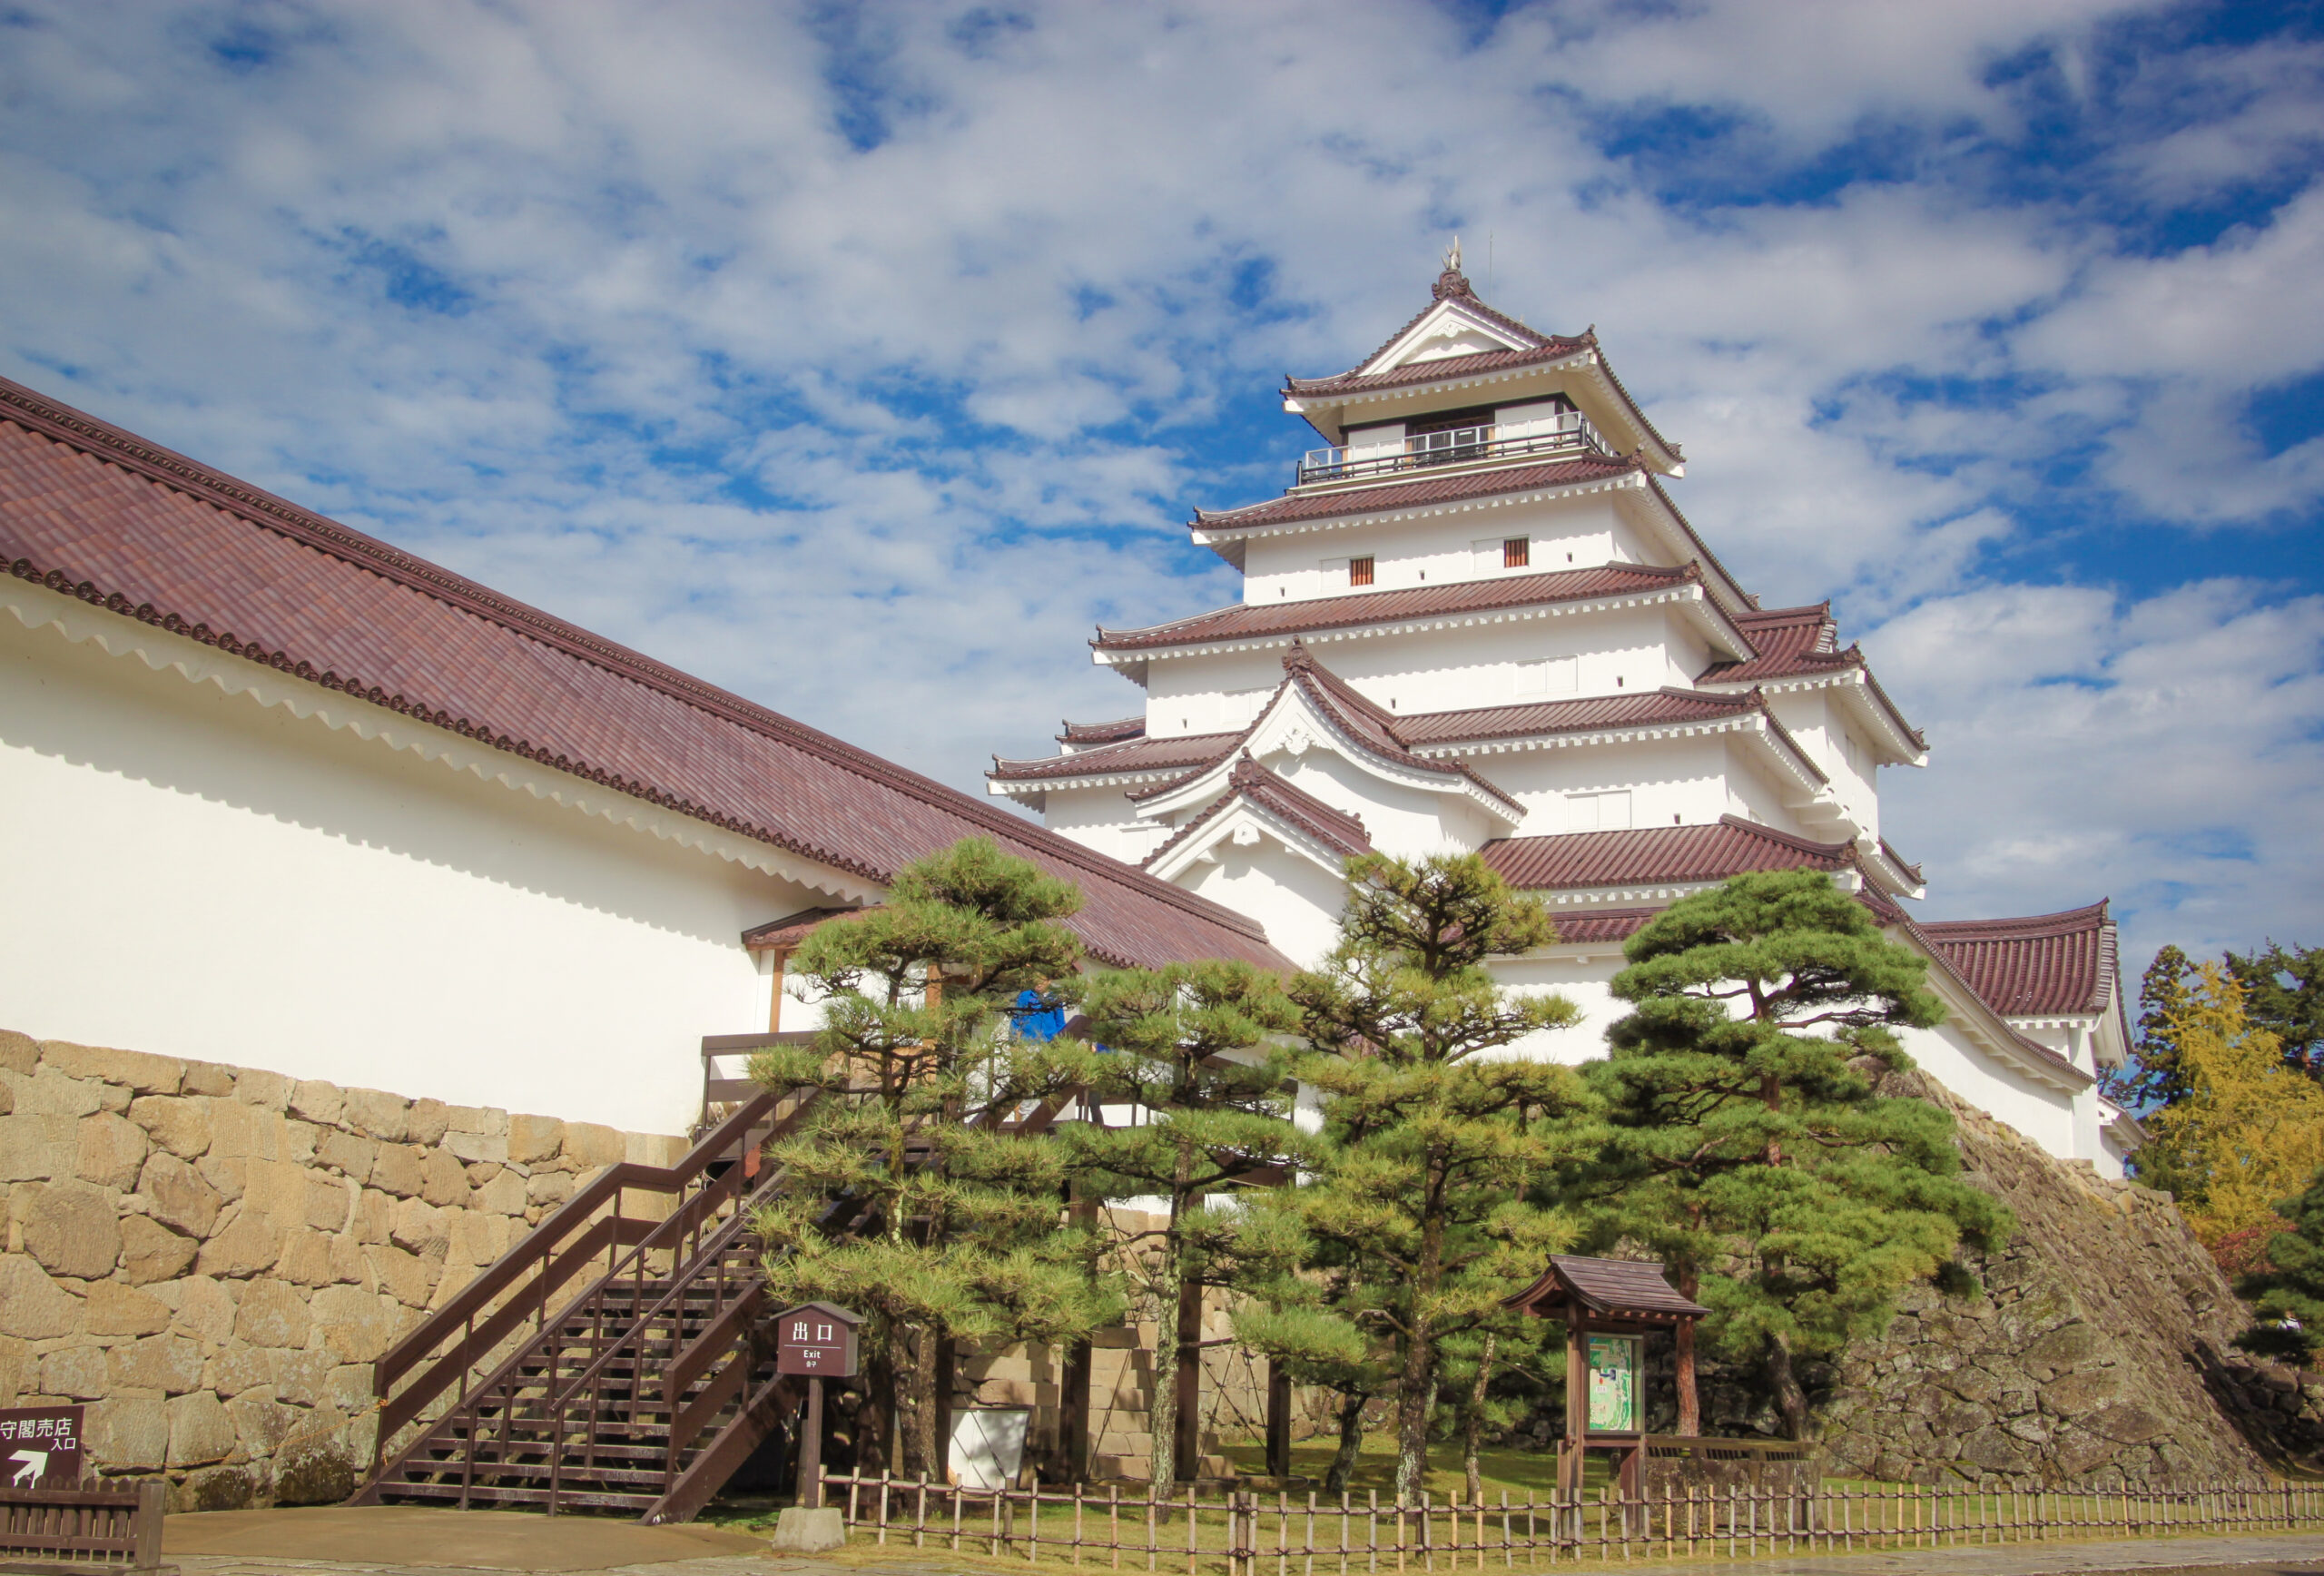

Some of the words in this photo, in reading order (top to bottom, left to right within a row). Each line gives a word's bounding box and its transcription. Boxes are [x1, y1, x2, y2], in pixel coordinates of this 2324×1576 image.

[793, 1322, 832, 1341] 出口
[803, 1350, 821, 1359] Exit
[0, 1417, 73, 1440] 守閣売店
[51, 1437, 76, 1451] 入口
